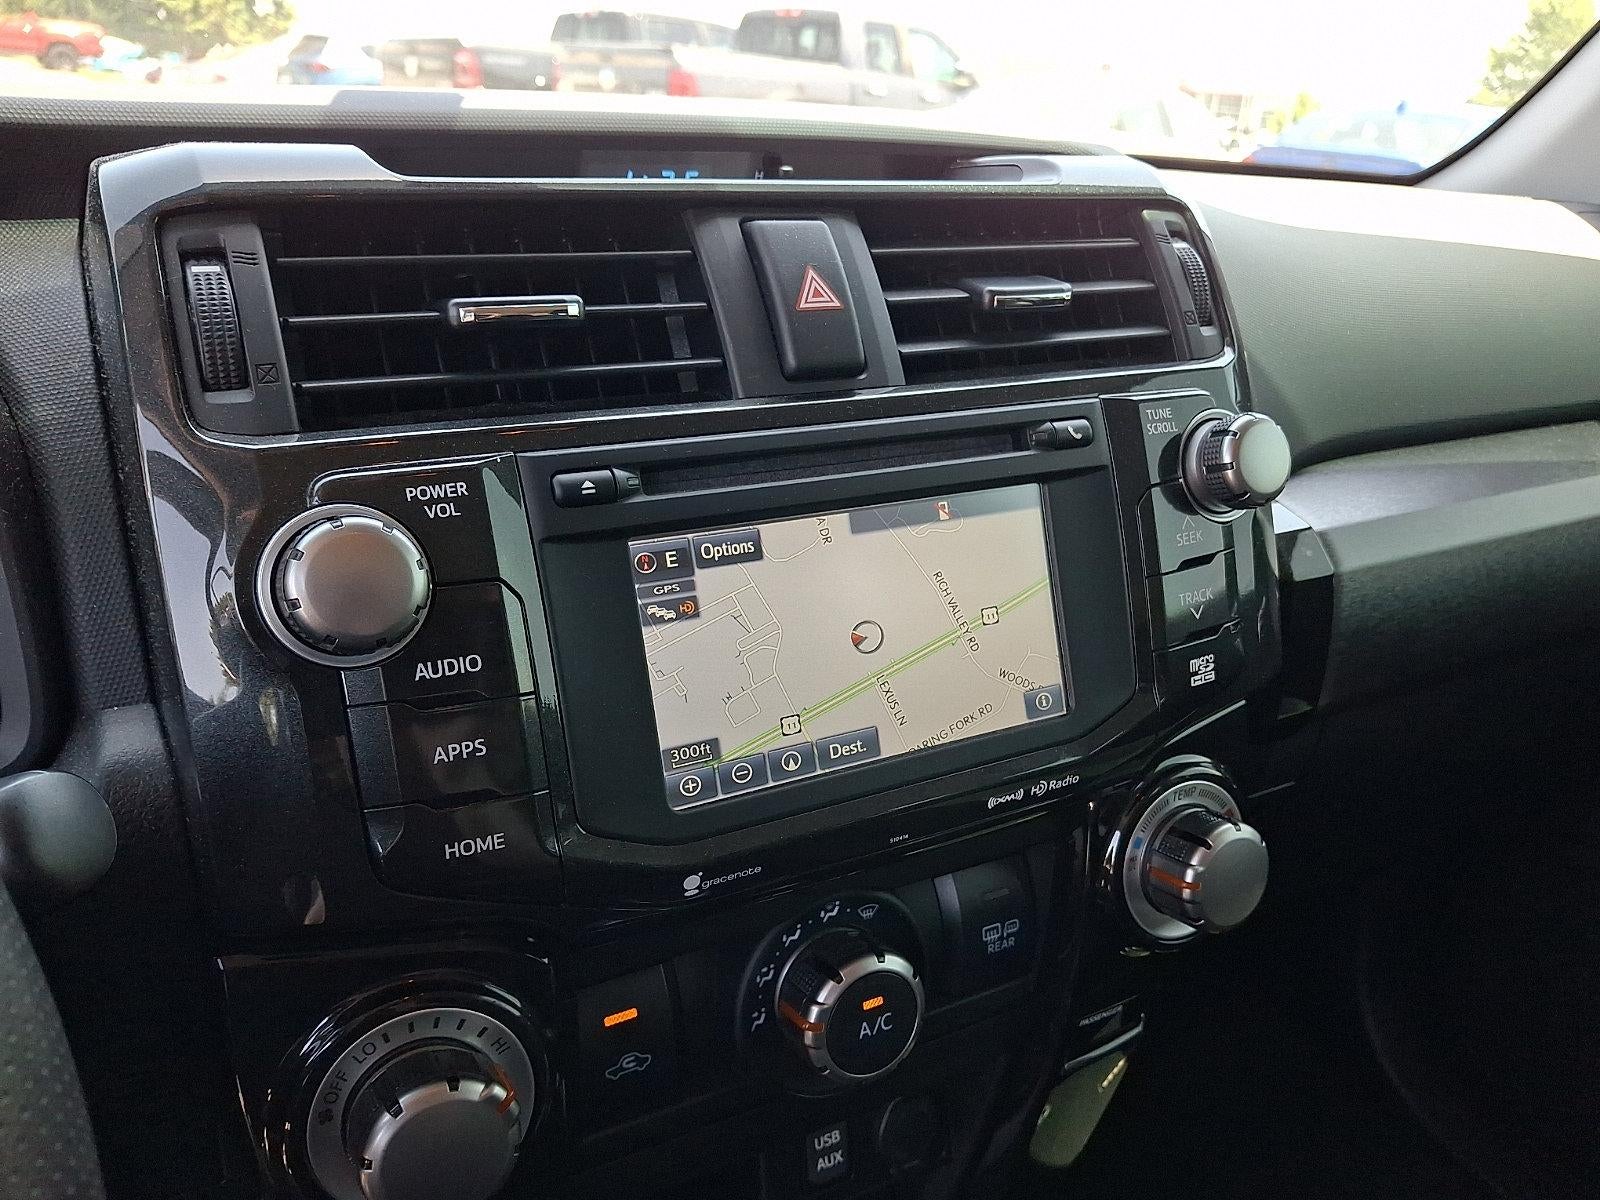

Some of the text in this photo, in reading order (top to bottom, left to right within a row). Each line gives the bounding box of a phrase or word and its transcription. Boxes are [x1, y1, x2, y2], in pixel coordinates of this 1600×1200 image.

[1146, 408, 1172, 420] TUNE
[1147, 422, 1178, 435] SCROLL
[405, 482, 469, 502] POWER
[423, 502, 461, 519] VOL
[819, 528, 832, 545] DR
[1176, 530, 1203, 546] SEEK
[665, 551, 679, 568] E
[700, 541, 755, 562] Options
[653, 583, 681, 595] GPS
[1178, 588, 1214, 606] TRACK
[933, 571, 980, 653] RICH VALLEY RD
[414, 654, 482, 681] AUDIO
[999, 668, 1036, 691] WOODS
[876, 674, 908, 728] LEXUS LN
[786, 721, 797, 731] 11
[949, 714, 978, 735] FORK
[978, 703, 994, 718] RD
[433, 738, 487, 765] APPS
[670, 743, 712, 763] 300ft
[829, 740, 867, 760] Dest.
[1048, 775, 1080, 791] Radio
[1173, 786, 1197, 802] TEMP
[444, 832, 506, 860] HOME
[701, 865, 762, 890] gracenote
[987, 936, 1015, 954] REAR
[859, 1012, 894, 1039] A/C
[490, 1038, 511, 1056] HI
[324, 1042, 376, 1105] OFF LO
[814, 1130, 841, 1150] USB
[817, 1150, 845, 1172] AUX
